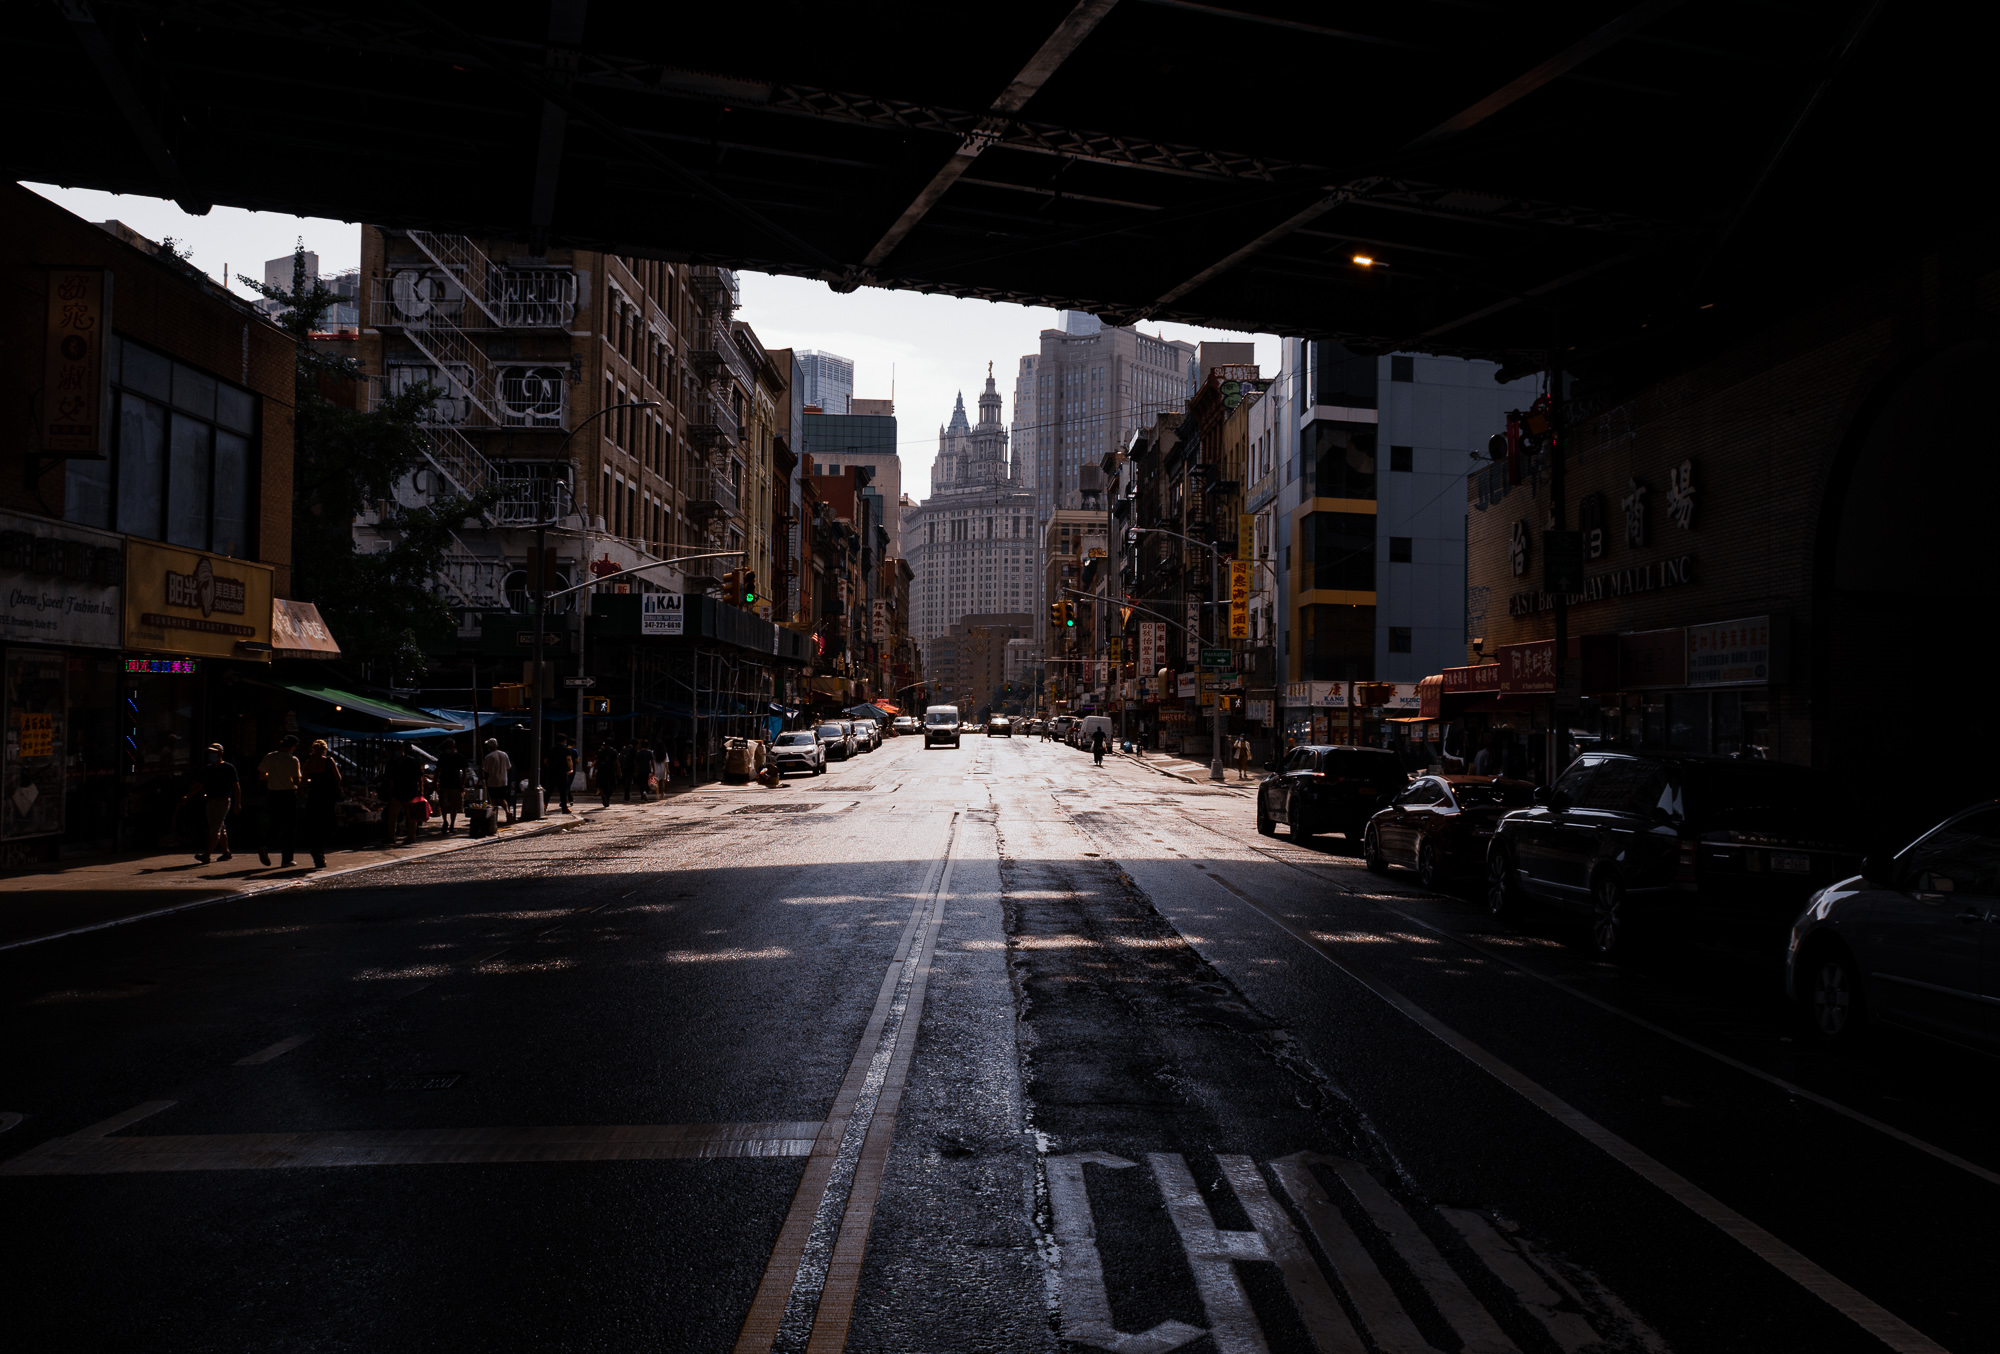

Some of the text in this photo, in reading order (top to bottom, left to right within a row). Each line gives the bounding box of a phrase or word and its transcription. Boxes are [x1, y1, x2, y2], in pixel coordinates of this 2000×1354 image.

[1609, 565, 1655, 598] MALL
[65, 596, 99, 615] Fashion
[214, 599, 244, 613] SUNSHINE
[657, 596, 681, 609] KAJ
[150, 615, 253, 636] SUNSHINE BEAUTY SALON
